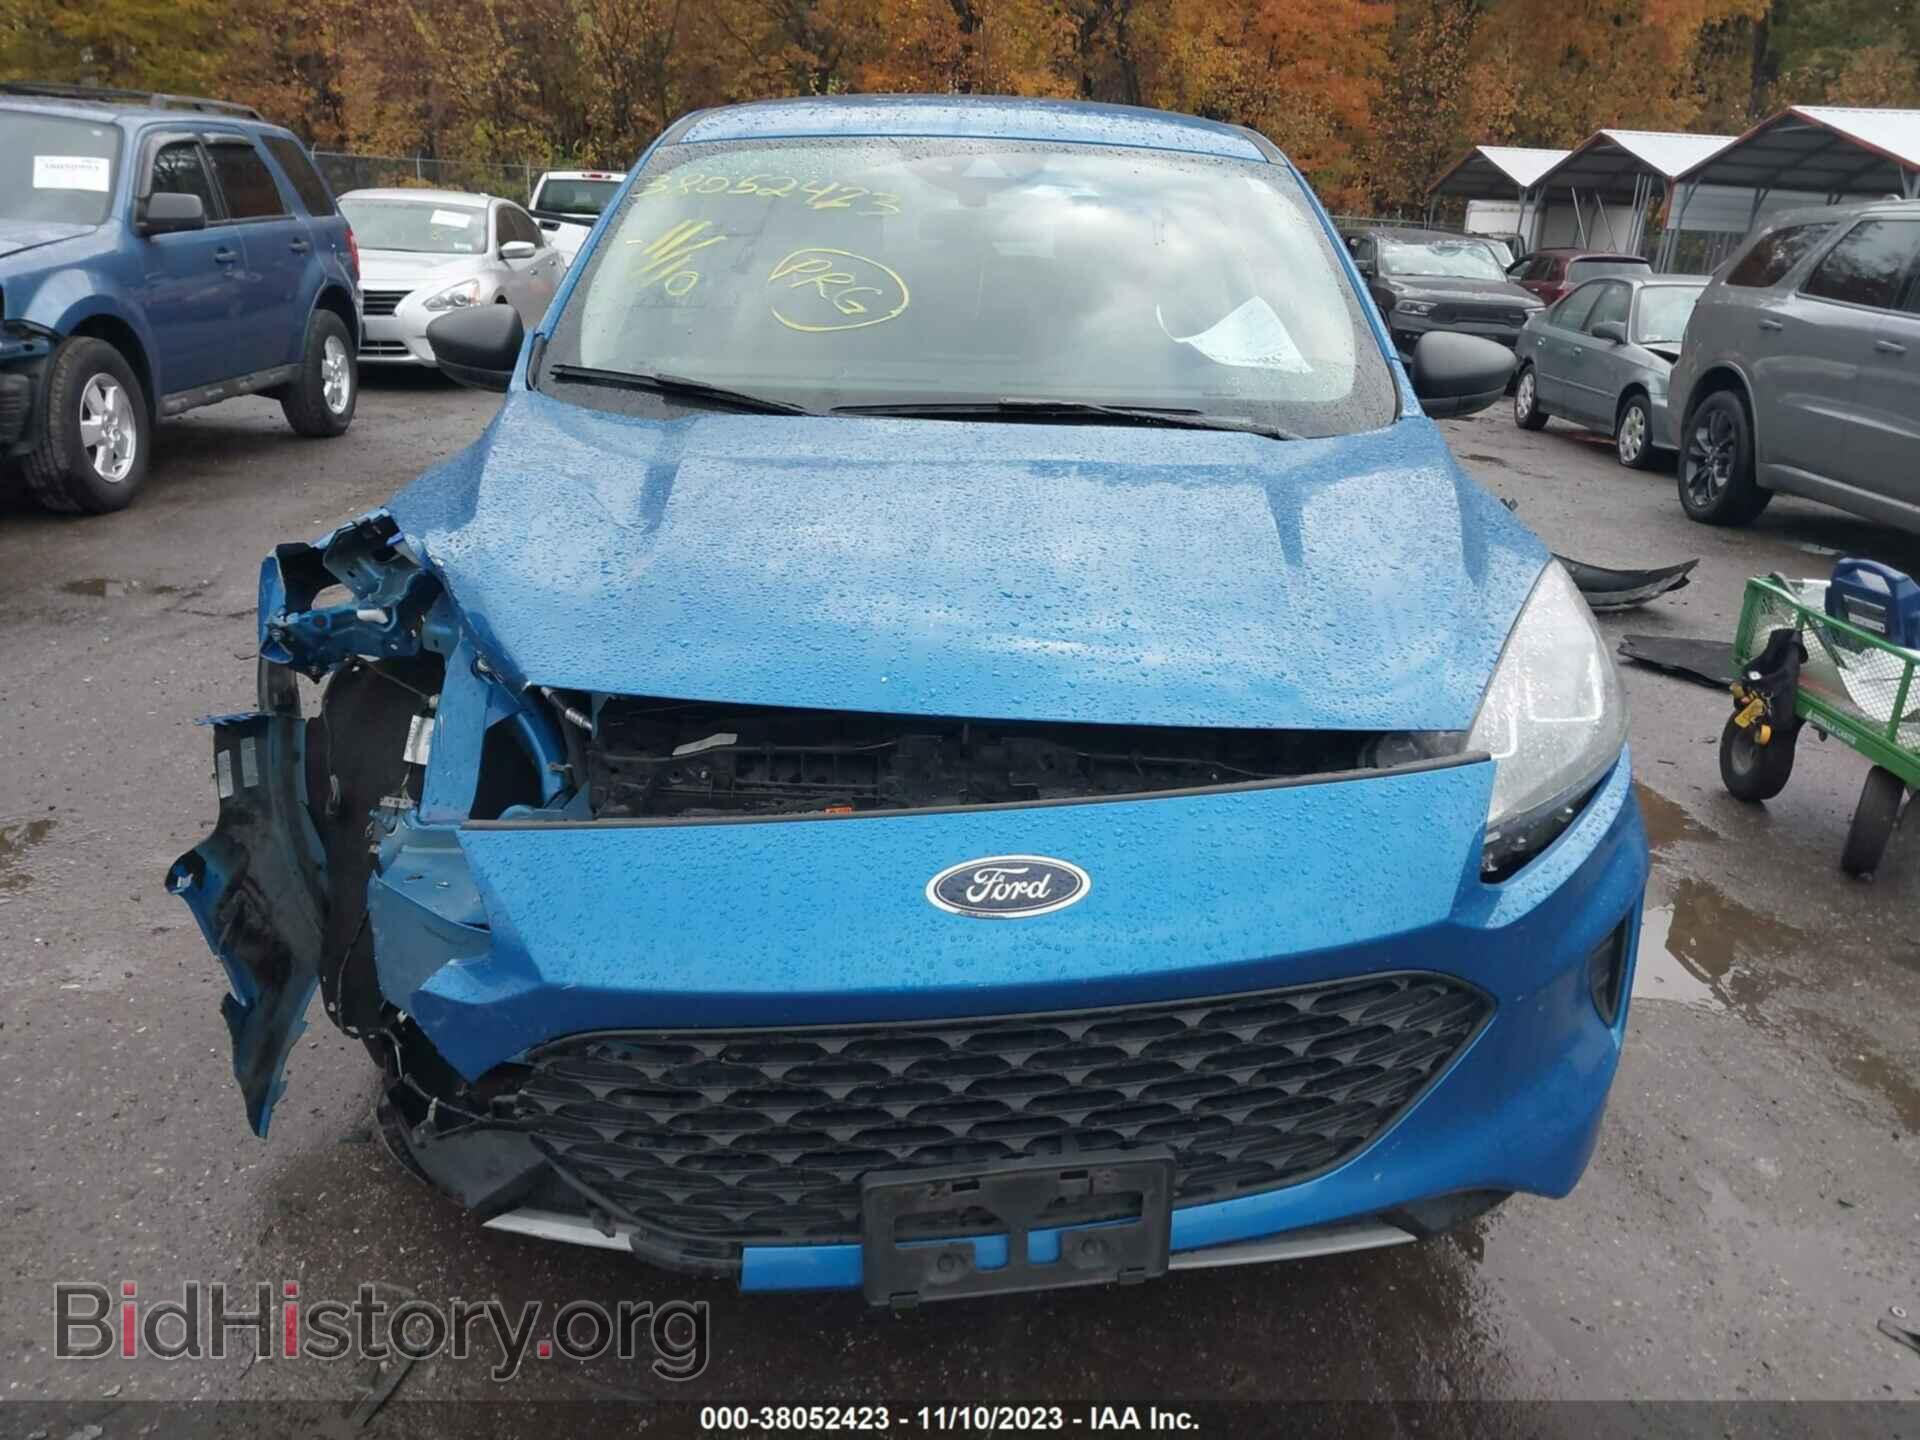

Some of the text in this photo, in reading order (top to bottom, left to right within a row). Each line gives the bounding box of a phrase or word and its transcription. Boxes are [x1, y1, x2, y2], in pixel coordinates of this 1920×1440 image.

[632, 173, 900, 217] 38052423
[768, 258, 884, 315] PRG
[966, 867, 1052, 903] Ford
